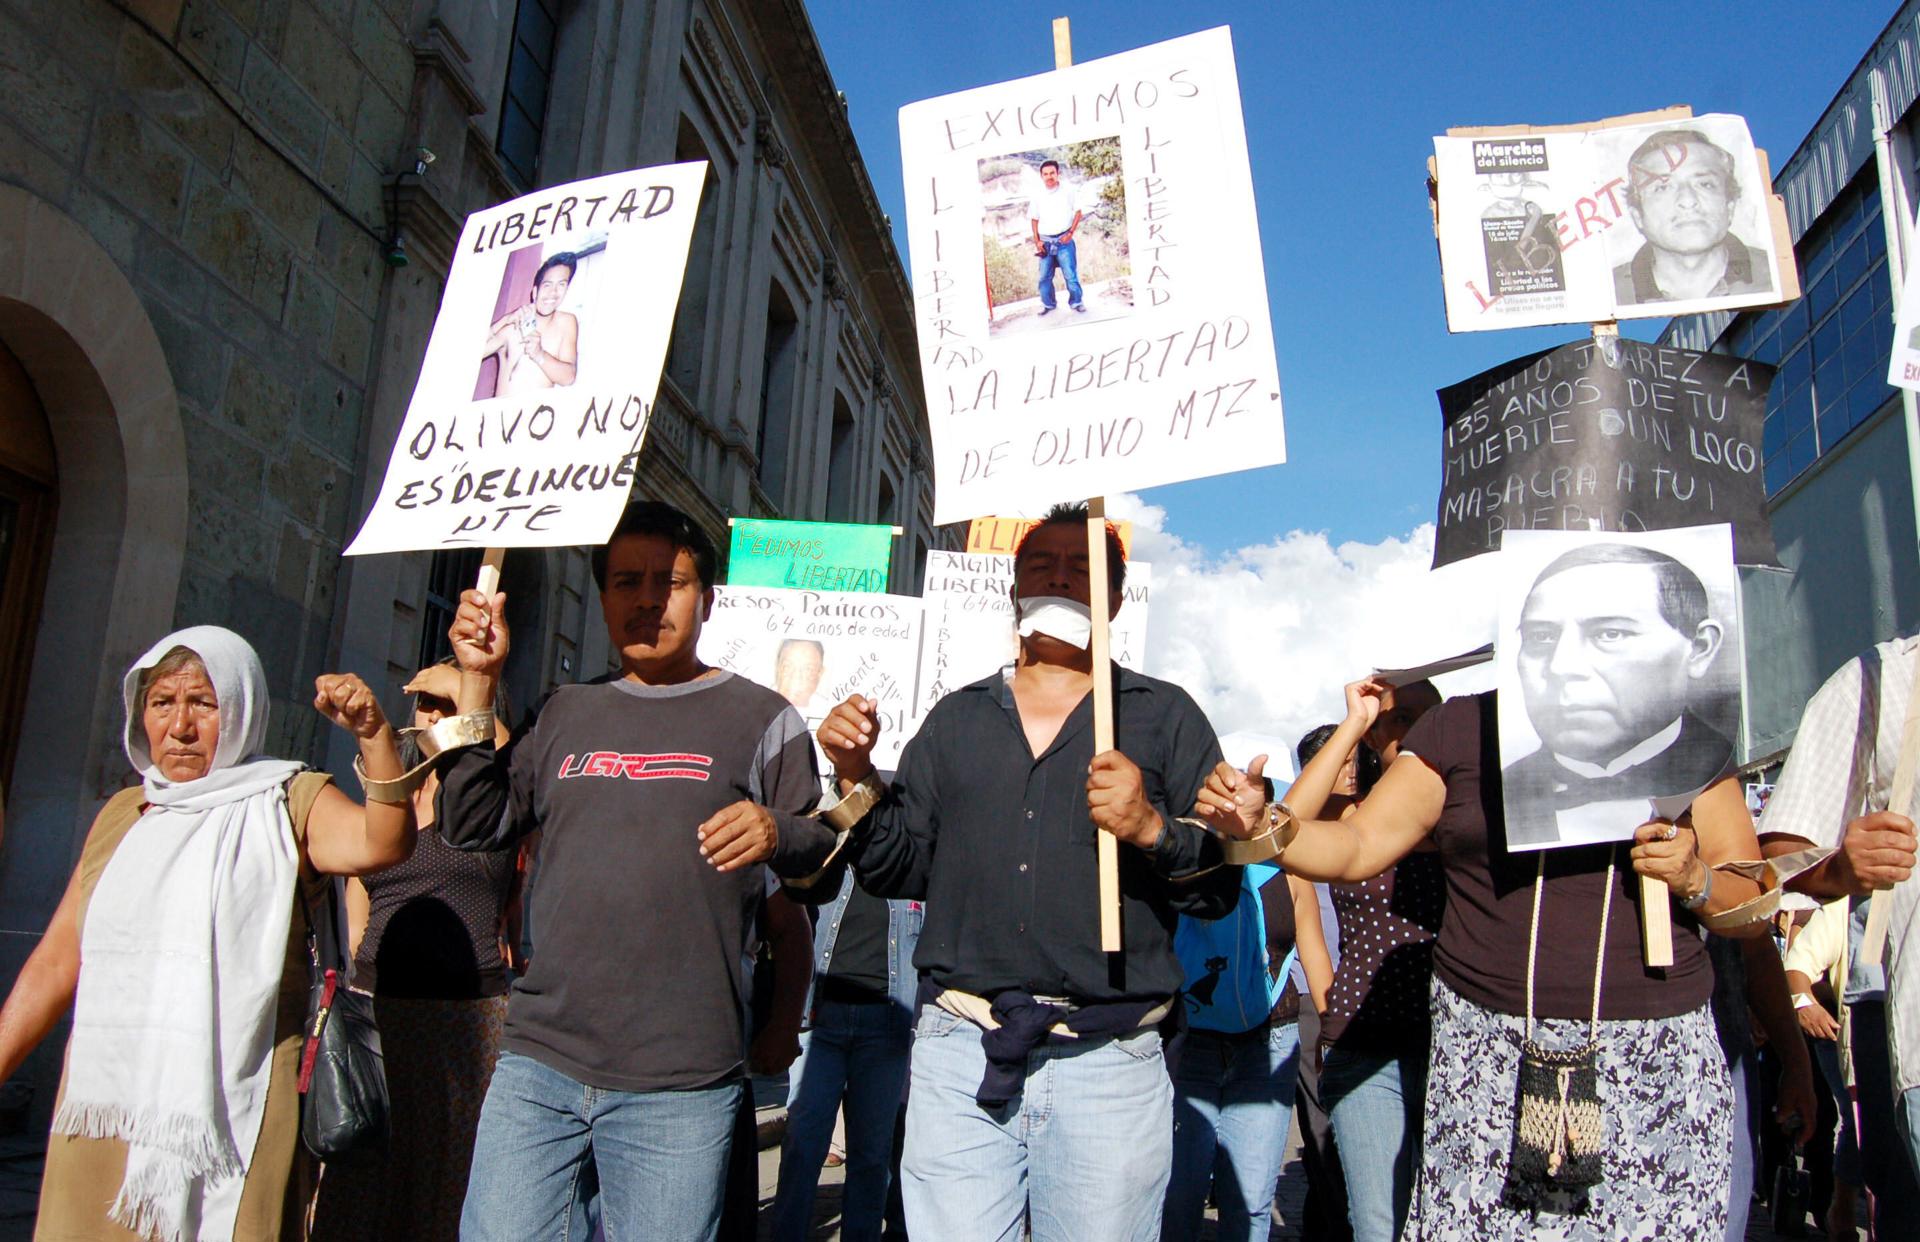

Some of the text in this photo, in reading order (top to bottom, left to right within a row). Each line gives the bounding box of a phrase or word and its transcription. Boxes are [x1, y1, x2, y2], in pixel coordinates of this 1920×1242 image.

[945, 69, 1200, 151] EXIGIMOS
[1475, 141, 1545, 157] Marcha
[1477, 154, 1544, 167] del silencio
[473, 186, 675, 255] LIBERTAD
[949, 315, 1250, 415] LA LIBERTAD
[1724, 363, 1751, 391] A
[409, 404, 556, 461] OLIVO
[1448, 376, 1726, 448] 135 AÑOS DE TU
[959, 440, 1010, 486] DE
[1033, 416, 1144, 467] OLIVO
[1445, 410, 1576, 487] MUERTE
[1689, 424, 1756, 474] LOCO
[451, 504, 563, 535] NTE
[1444, 460, 1695, 528] MASACRA A TU
[738, 522, 826, 561] PEDIMOS
[783, 562, 883, 594] LIBERTAD
[766, 613, 795, 634] 64
[847, 620, 868, 635] de
[872, 622, 911, 640] edad
